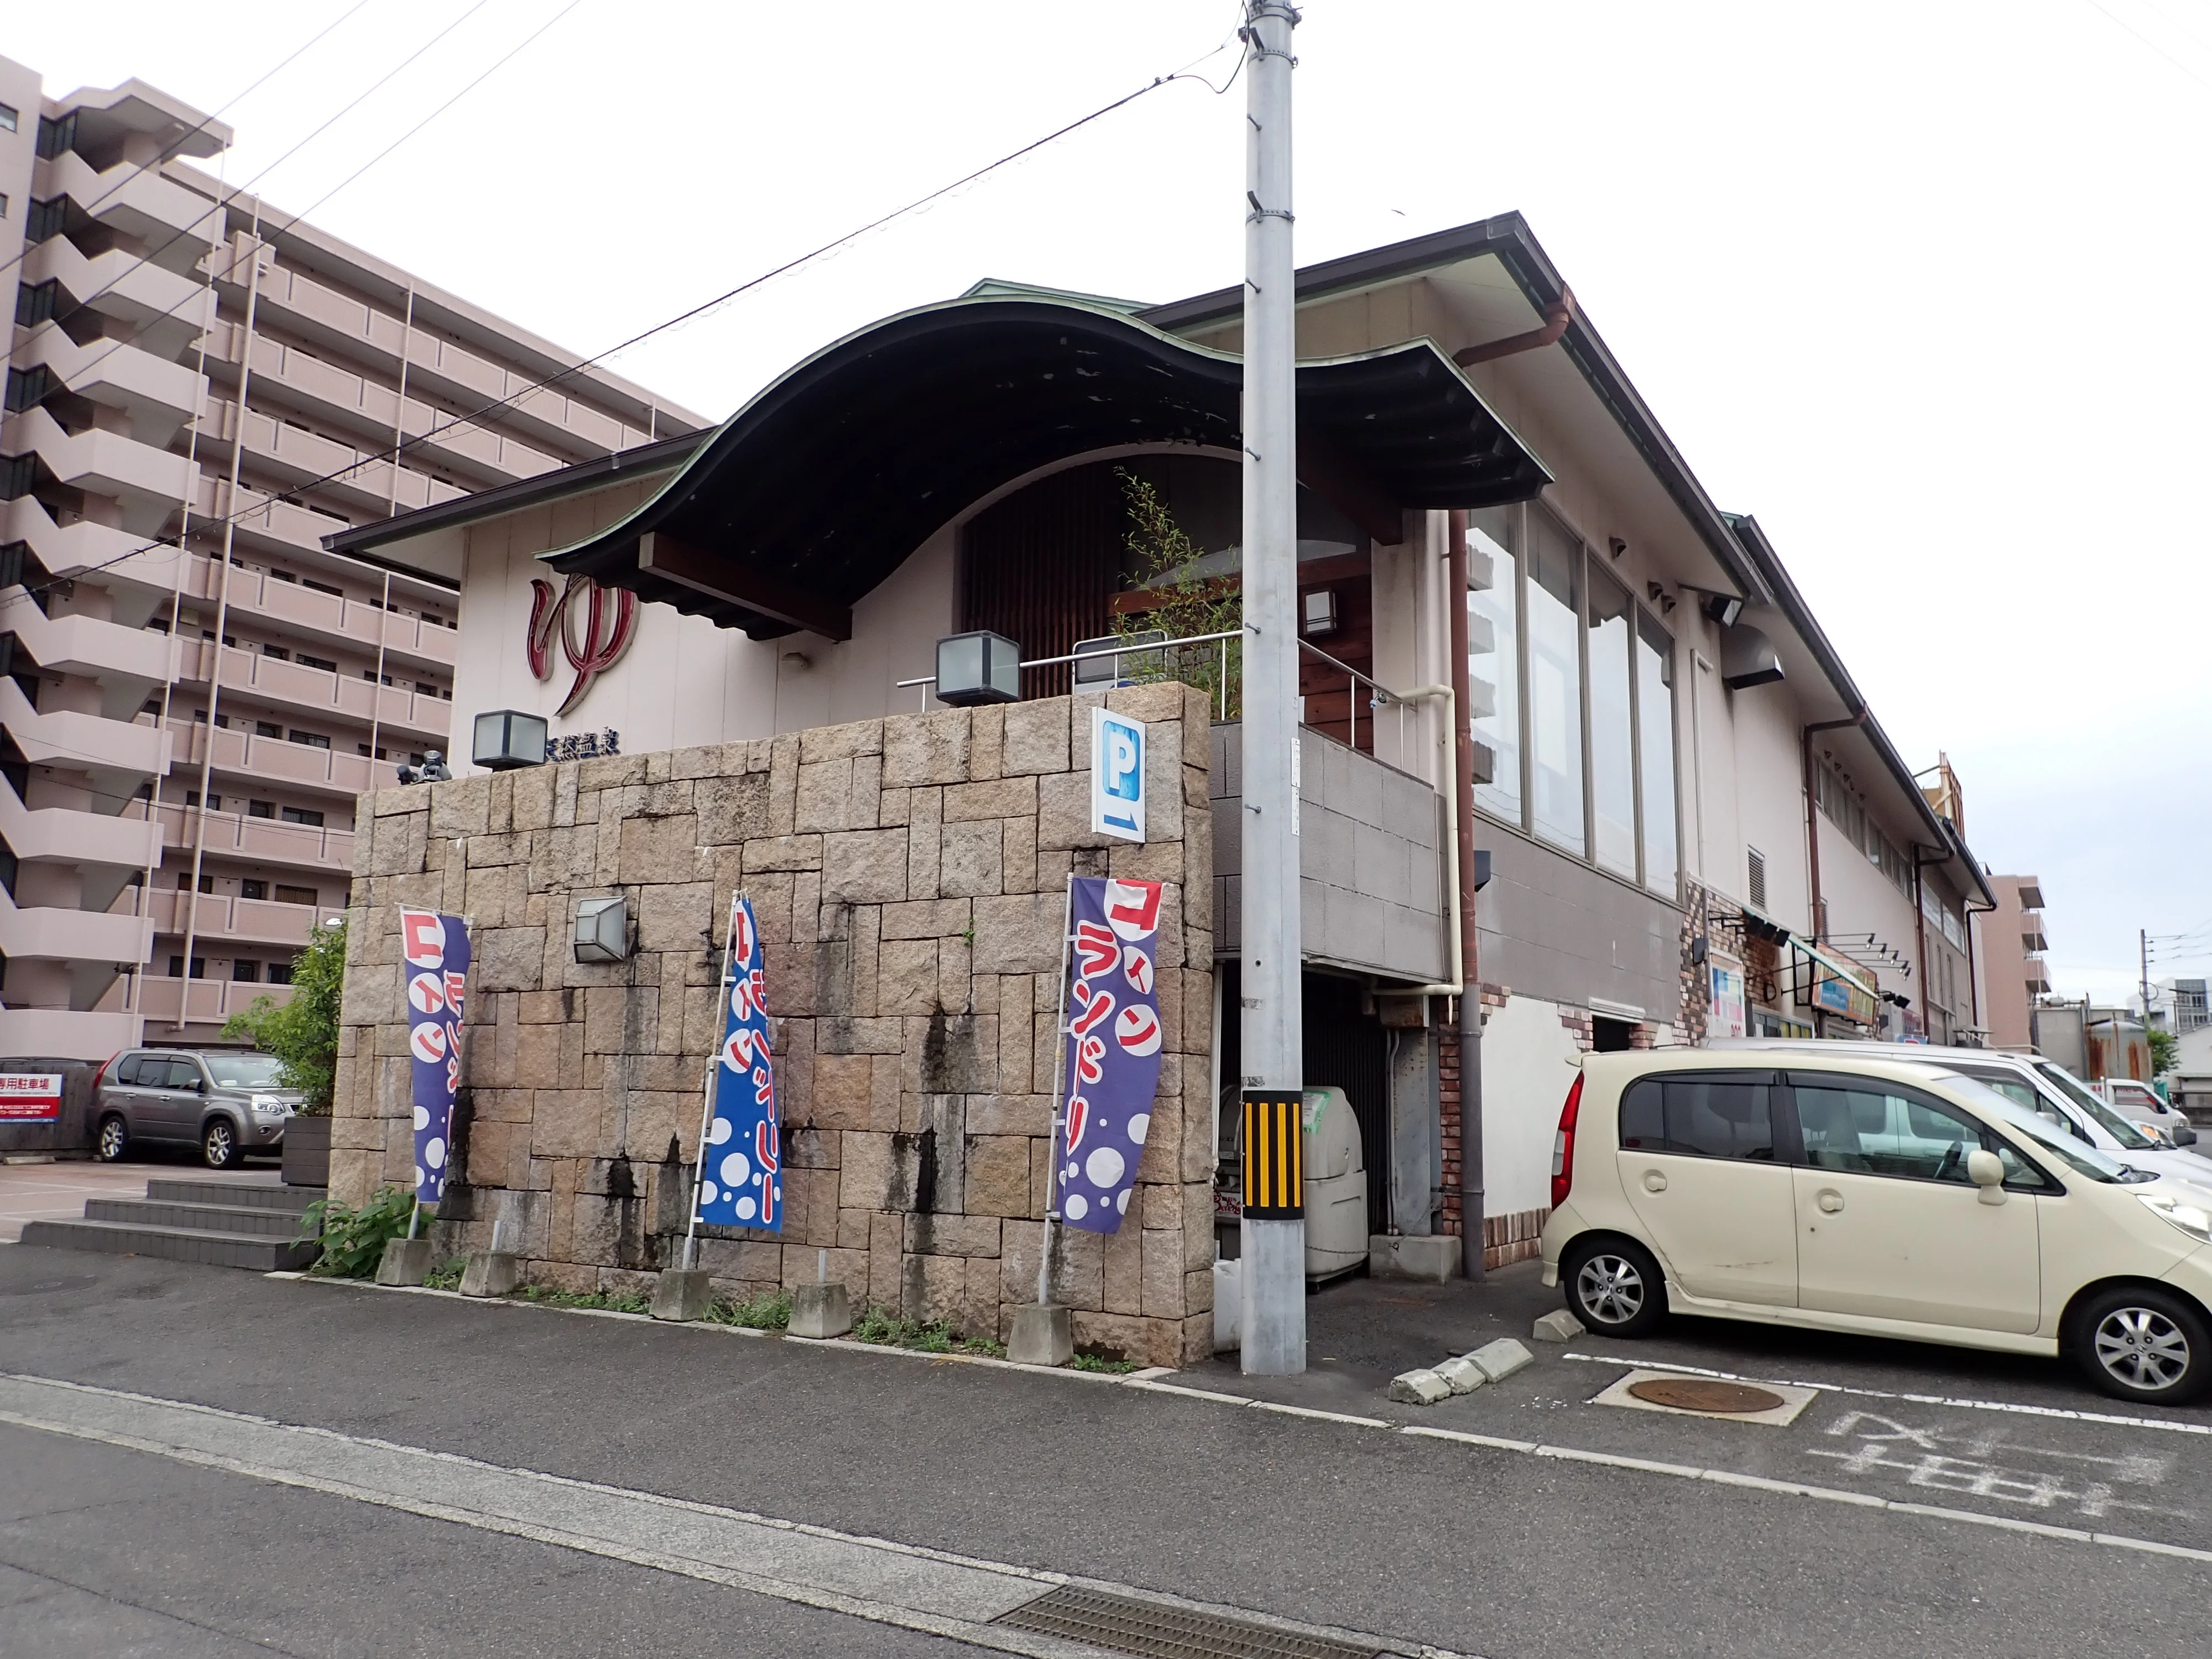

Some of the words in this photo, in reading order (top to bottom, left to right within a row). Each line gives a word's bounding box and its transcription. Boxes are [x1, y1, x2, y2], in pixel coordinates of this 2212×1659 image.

[1109, 731, 1136, 790] P
[1069, 921, 1121, 1155] ランドリ
[1109, 878, 1163, 1047] コイン
